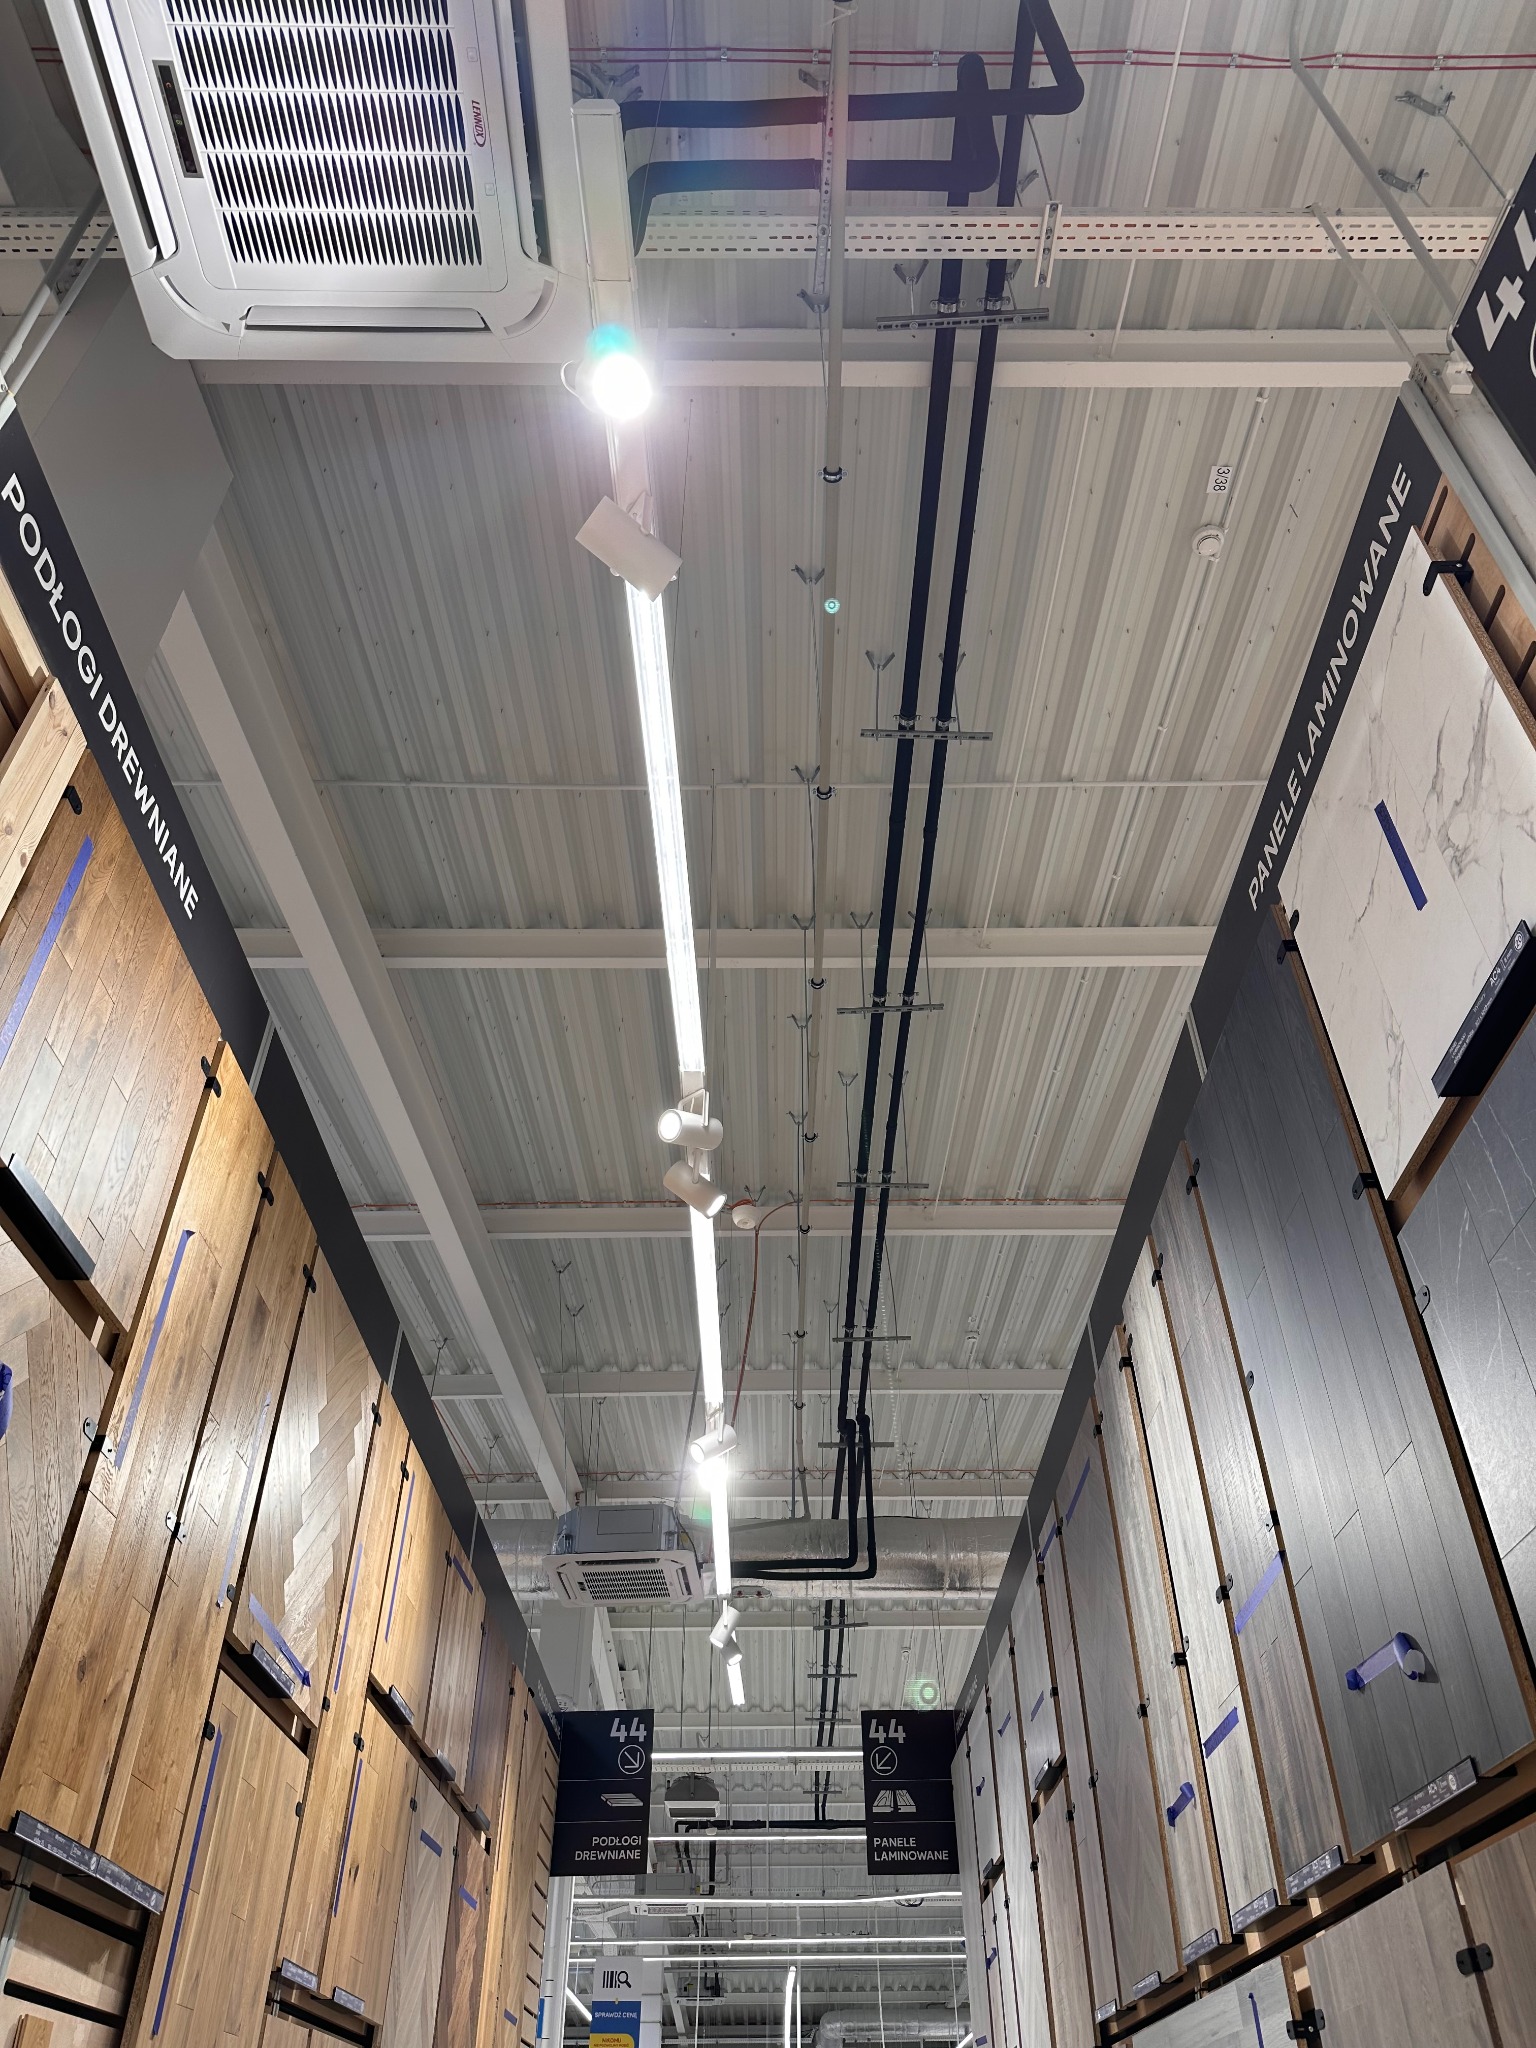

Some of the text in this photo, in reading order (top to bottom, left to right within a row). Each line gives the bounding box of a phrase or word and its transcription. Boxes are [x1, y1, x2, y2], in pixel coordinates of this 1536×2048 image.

[472, 99, 485, 139] LENNOX
[1213, 467, 1231, 492] 3/38
[1, 472, 199, 920] PODŁOGI DREWNIANE
[1248, 462, 1412, 911] PANELE LAMINOWANE
[610, 1717, 647, 1743] 44
[868, 1718, 907, 1744] 44
[592, 1835, 642, 1847] PODŁOGI
[873, 1837, 917, 1848] PANELE
[574, 1849, 641, 1861] DREWNIANE
[874, 1850, 949, 1861] LAMINOWANE
[594, 2010, 622, 2018] SPRAWDŹ
